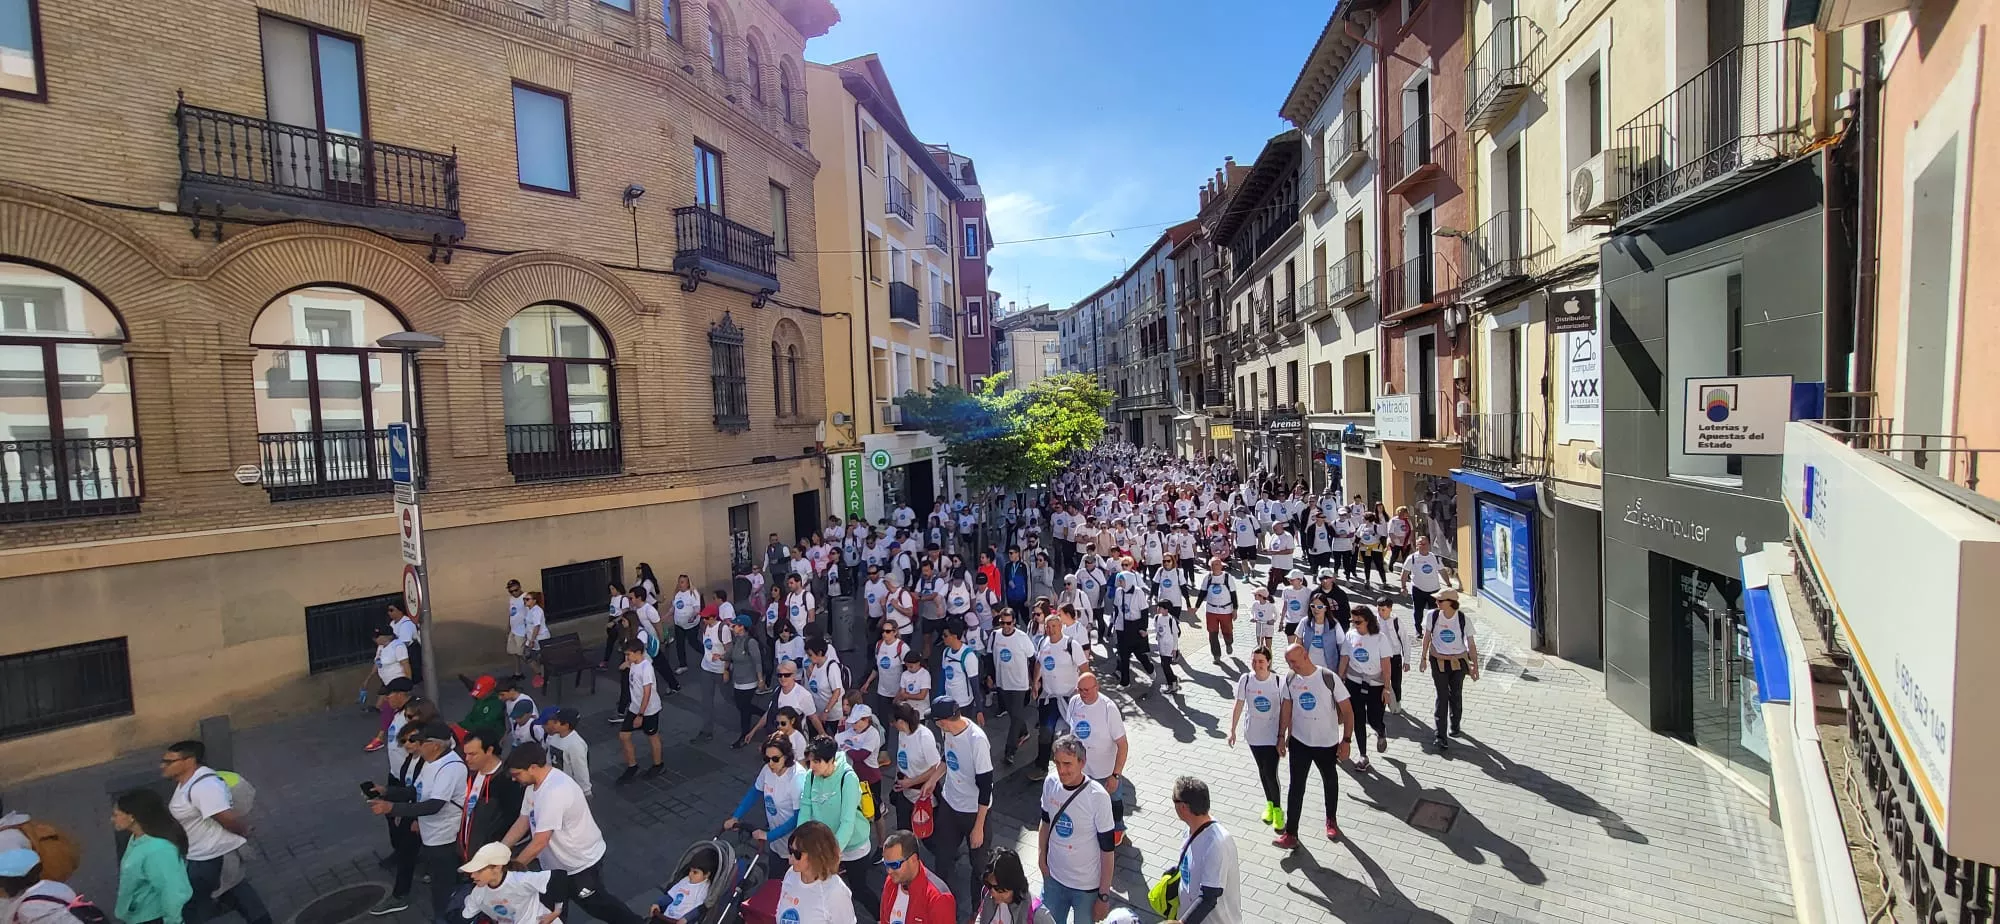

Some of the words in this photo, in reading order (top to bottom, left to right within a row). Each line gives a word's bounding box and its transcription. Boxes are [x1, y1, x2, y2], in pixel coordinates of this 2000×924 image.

[1555, 315, 1591, 323] Distribuidor
[1556, 322, 1589, 330] autorizado
[1571, 379, 1599, 398] XXX
[1382, 400, 1409, 413] hitradio
[1270, 420, 1301, 429] Arenas
[1698, 433, 1745, 441] Apuestas
[1641, 512, 1710, 542] ecomputer
